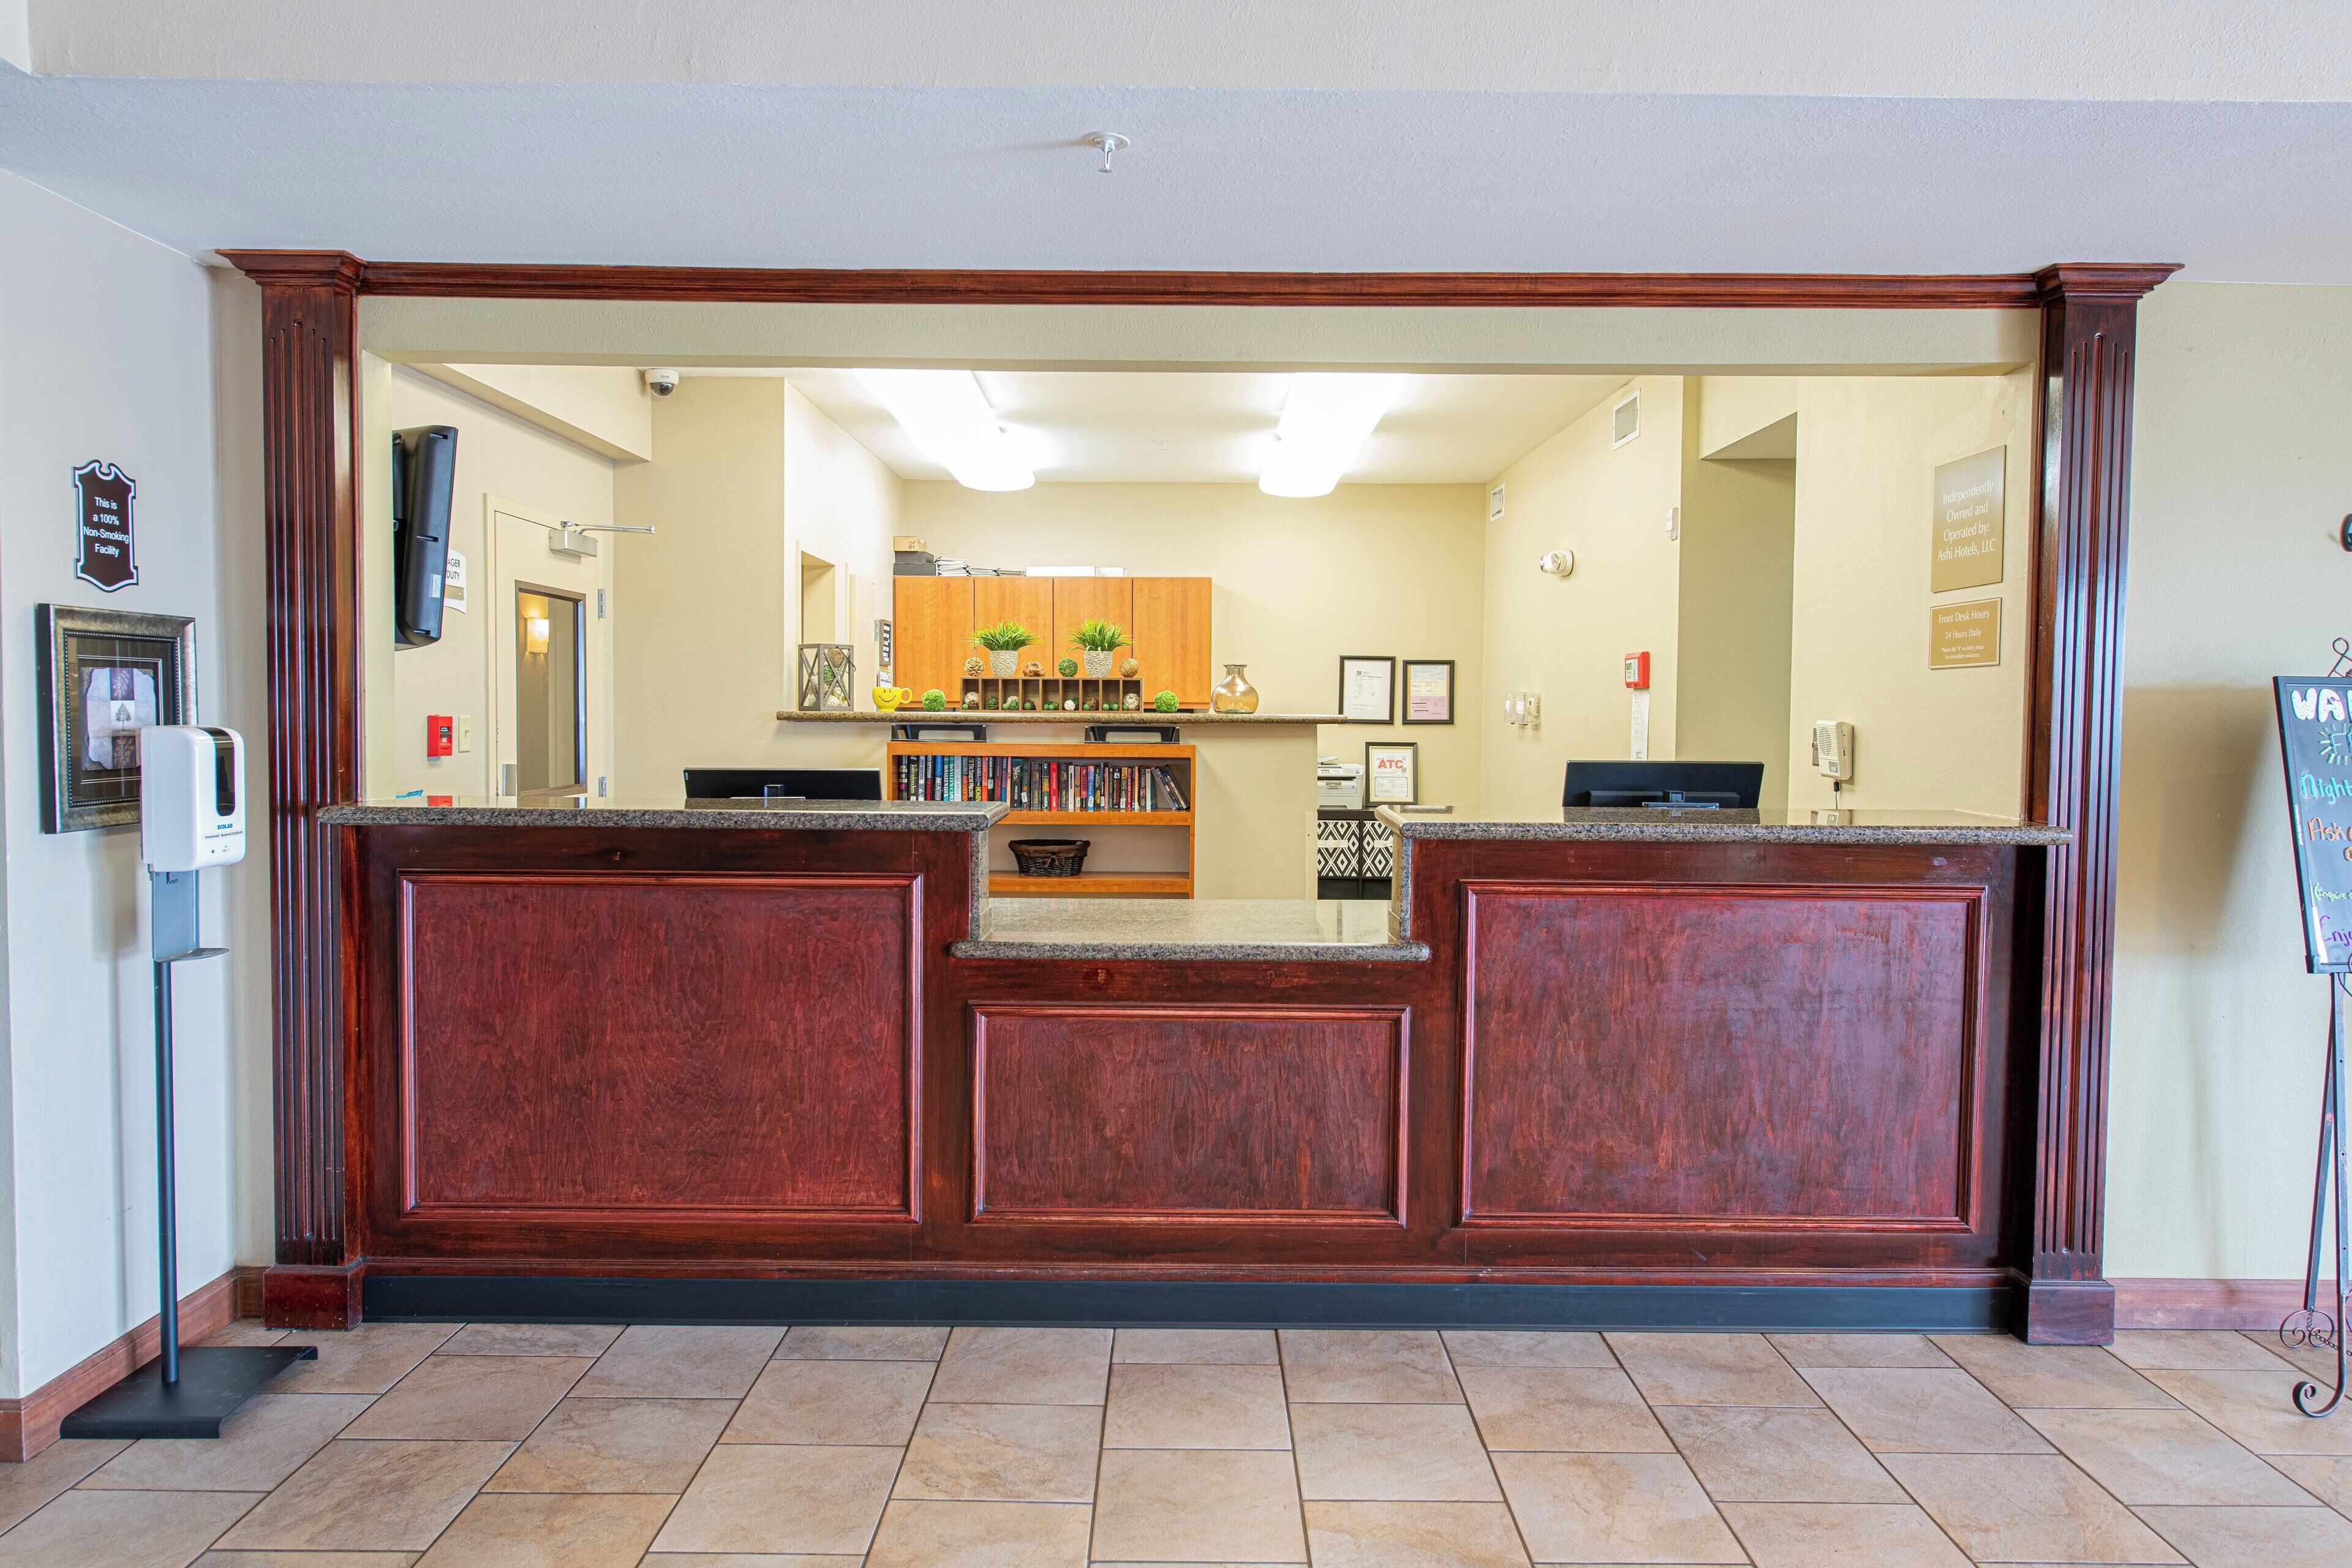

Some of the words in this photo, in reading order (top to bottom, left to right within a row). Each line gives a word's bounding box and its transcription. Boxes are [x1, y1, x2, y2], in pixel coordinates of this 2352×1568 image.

[1943, 479, 1994, 505] Independently
[94, 497, 110, 508] This
[111, 500, 118, 510] is
[1947, 503, 1973, 522] Owned
[1975, 500, 1988, 516] and
[100, 513, 119, 526] 100%
[83, 526, 129, 544] Non-Smoking
[1943, 522, 1977, 545] Operated
[1978, 521, 1990, 537] by:
[95, 543, 119, 557] Facility
[1937, 548, 1953, 561] Ashi
[1954, 542, 1980, 558] Hotels,
[1982, 538, 1996, 552] LLC
[447, 558, 461, 568] AGER
[447, 570, 460, 580] DUTY
[1939, 614, 1954, 624] Front
[1955, 611, 1970, 622] Desk
[1971, 610, 1989, 619] Hours
[1969, 628, 1981, 638] Daily
[1378, 760, 1403, 769] ATC
[2307, 816, 2346, 841] Ask
